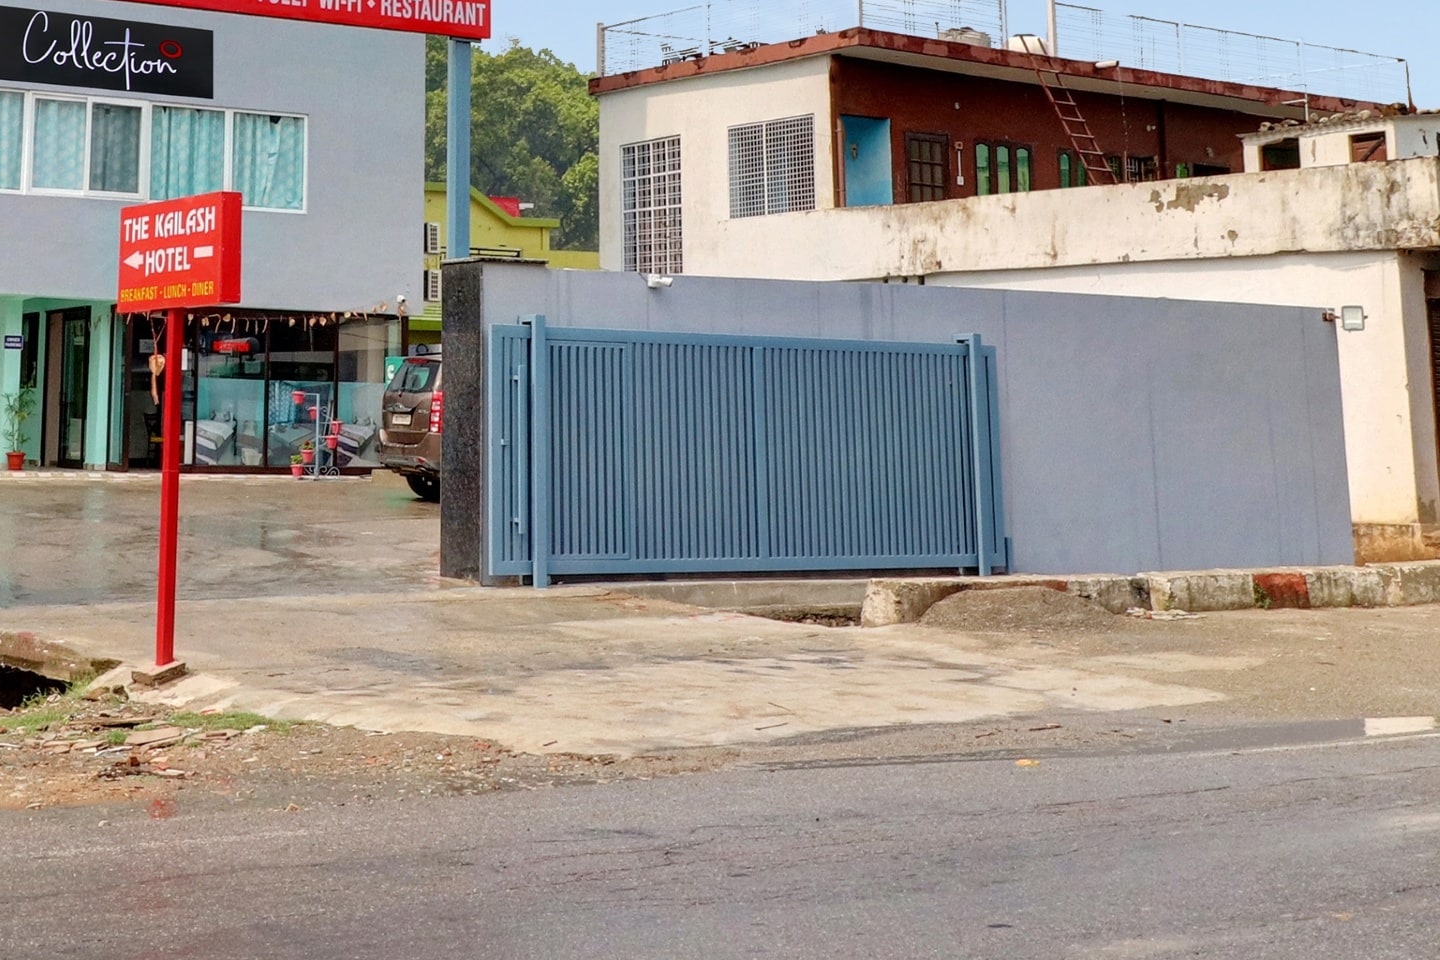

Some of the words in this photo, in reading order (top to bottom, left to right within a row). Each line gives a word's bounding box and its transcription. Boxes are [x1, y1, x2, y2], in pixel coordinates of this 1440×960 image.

[23, 11, 178, 91] Collection
[124, 216, 149, 244] THE
[155, 206, 216, 239] KAILASH
[144, 246, 191, 278] HOTEL
[120, 285, 158, 303] BREAKFAST
[163, 283, 187, 300] LUNCH
